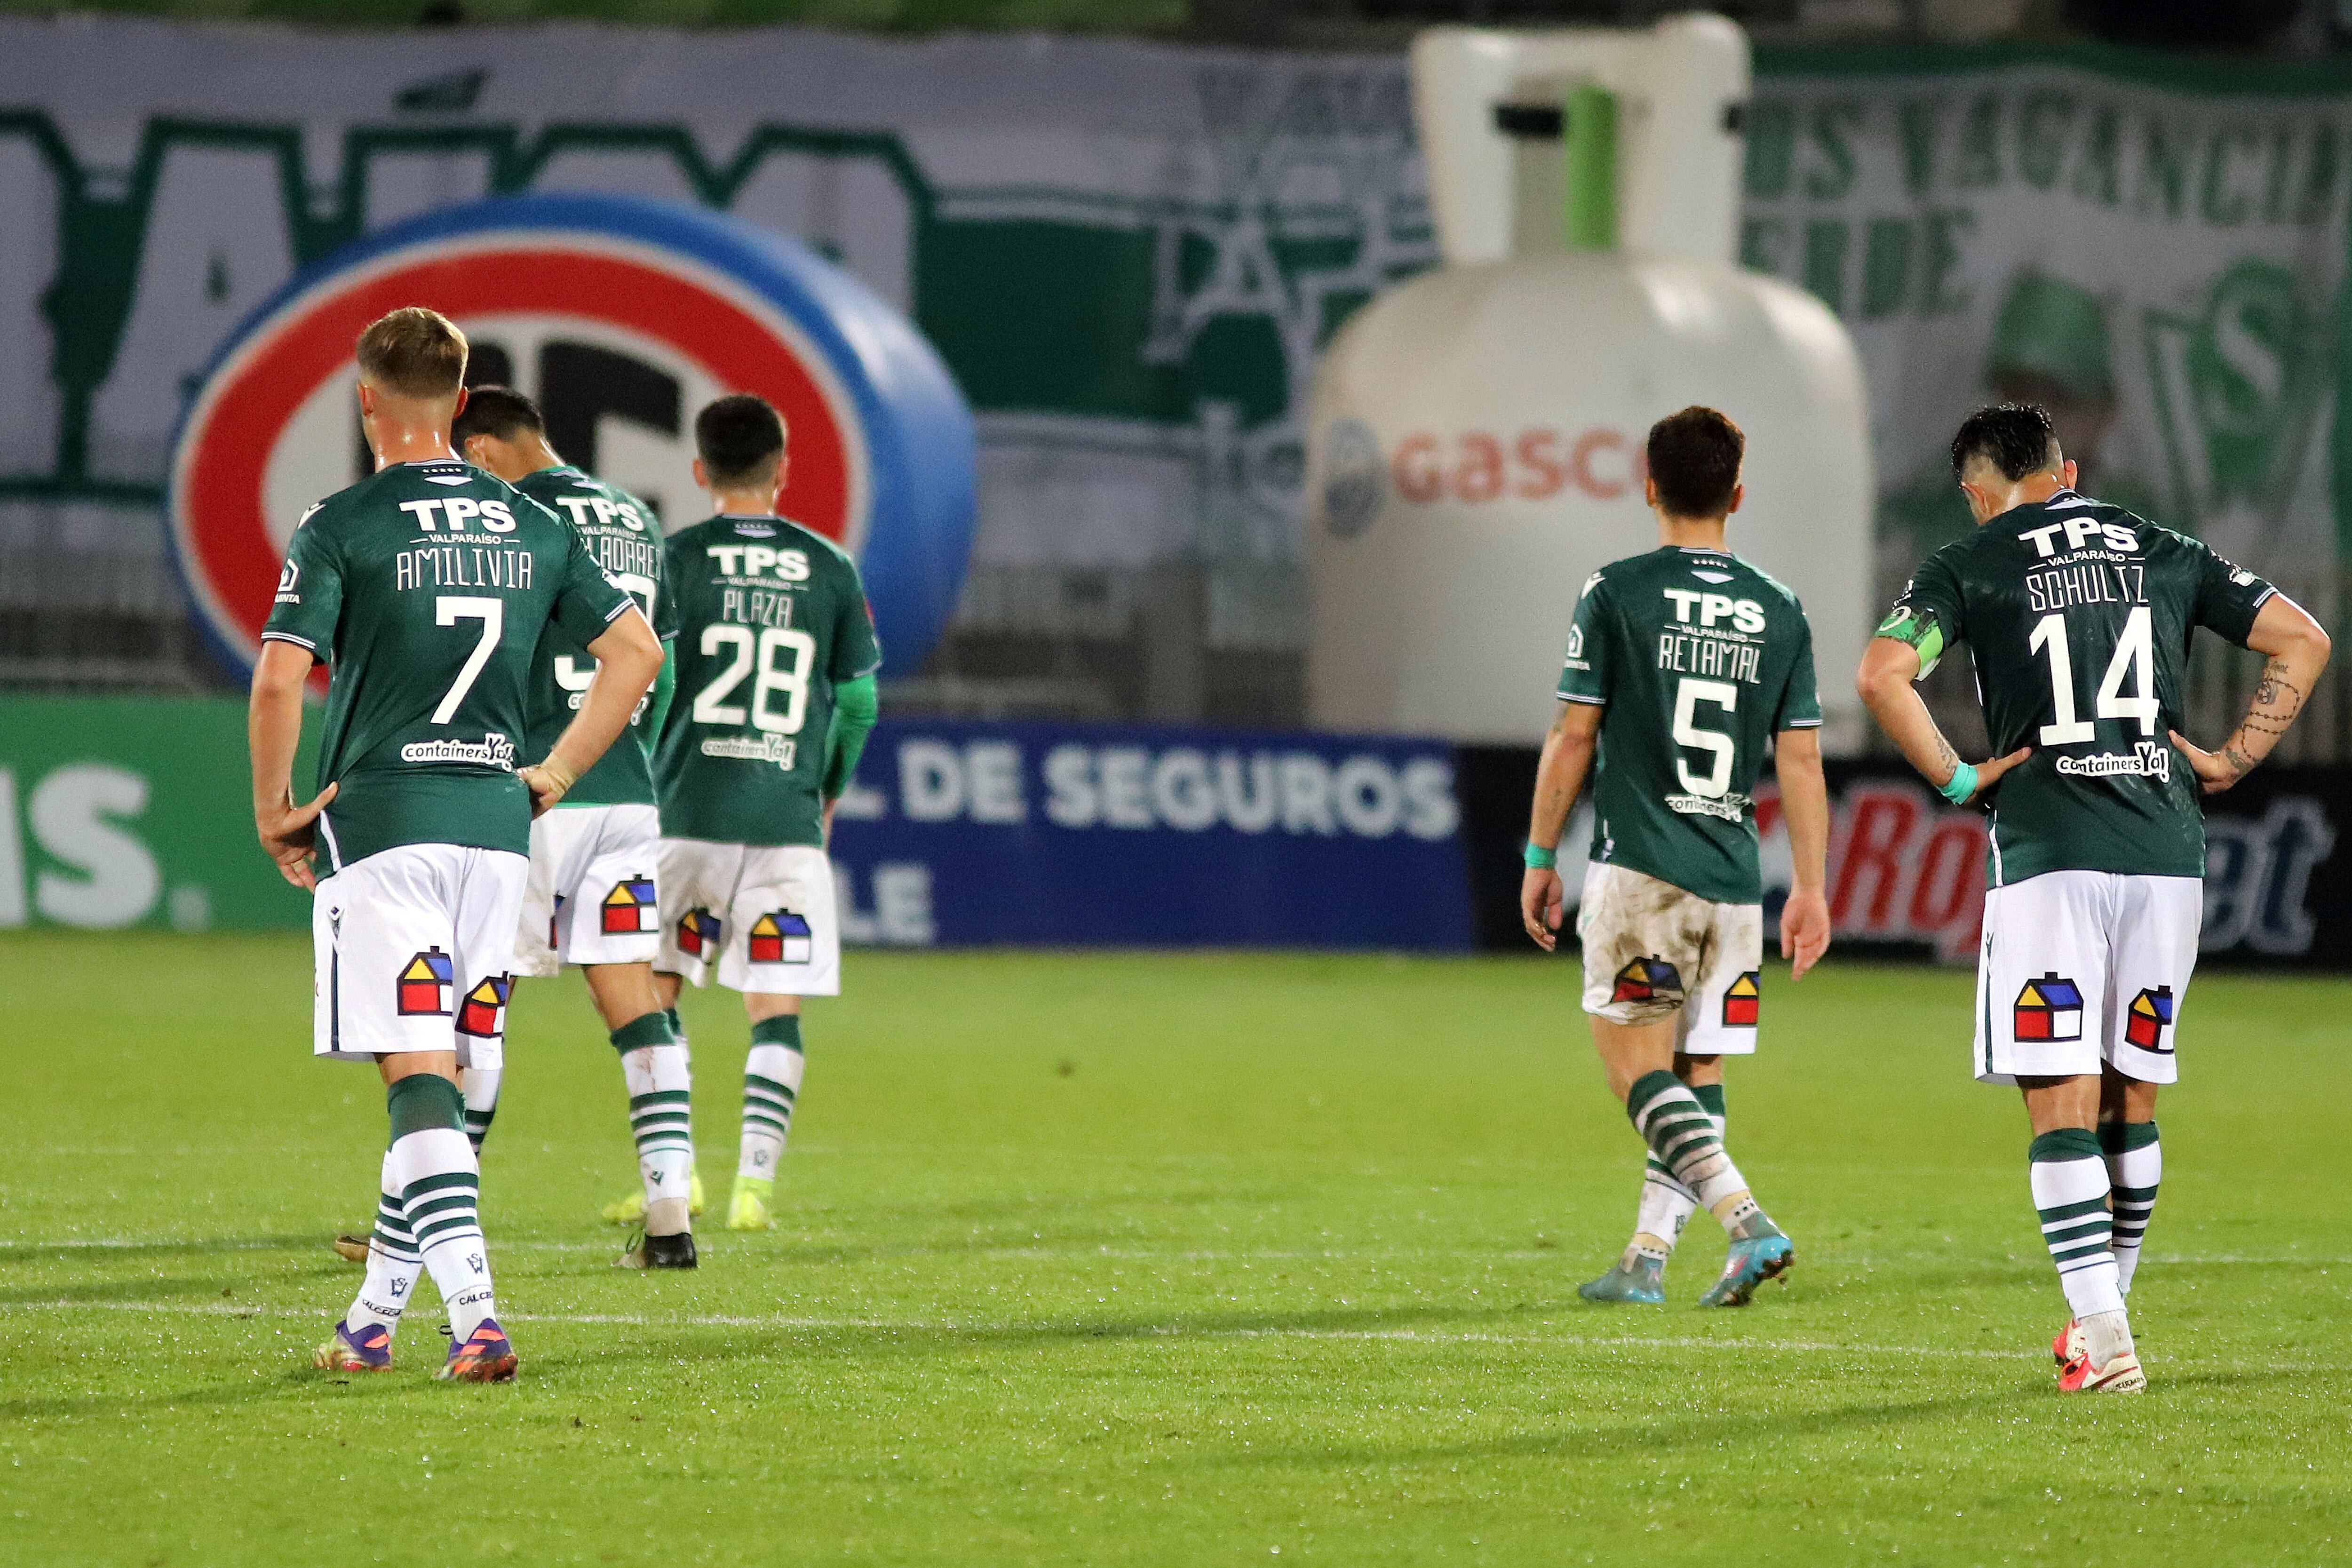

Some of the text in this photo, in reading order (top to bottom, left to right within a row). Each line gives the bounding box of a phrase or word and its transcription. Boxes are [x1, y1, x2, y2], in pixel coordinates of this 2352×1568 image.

[398, 497, 516, 533] TPS
[555, 497, 644, 532] TPS
[2017, 517, 2139, 557] TPS
[429, 533, 501, 545] VALPARAÍSO
[397, 548, 532, 591] AMILIVIA
[707, 545, 811, 581] TPS
[723, 590, 793, 629] PLAZA
[1663, 588, 1766, 634] TPS
[2026, 565, 2149, 612] SCHULTZ
[430, 596, 502, 724] 7
[693, 624, 816, 735] 28
[1659, 633, 1762, 684] RETAMAL
[2029, 606, 2160, 746] 14
[1673, 677, 1737, 799] 5
[899, 740, 1024, 823] DE
[1045, 744, 1459, 841] SEGUROS
